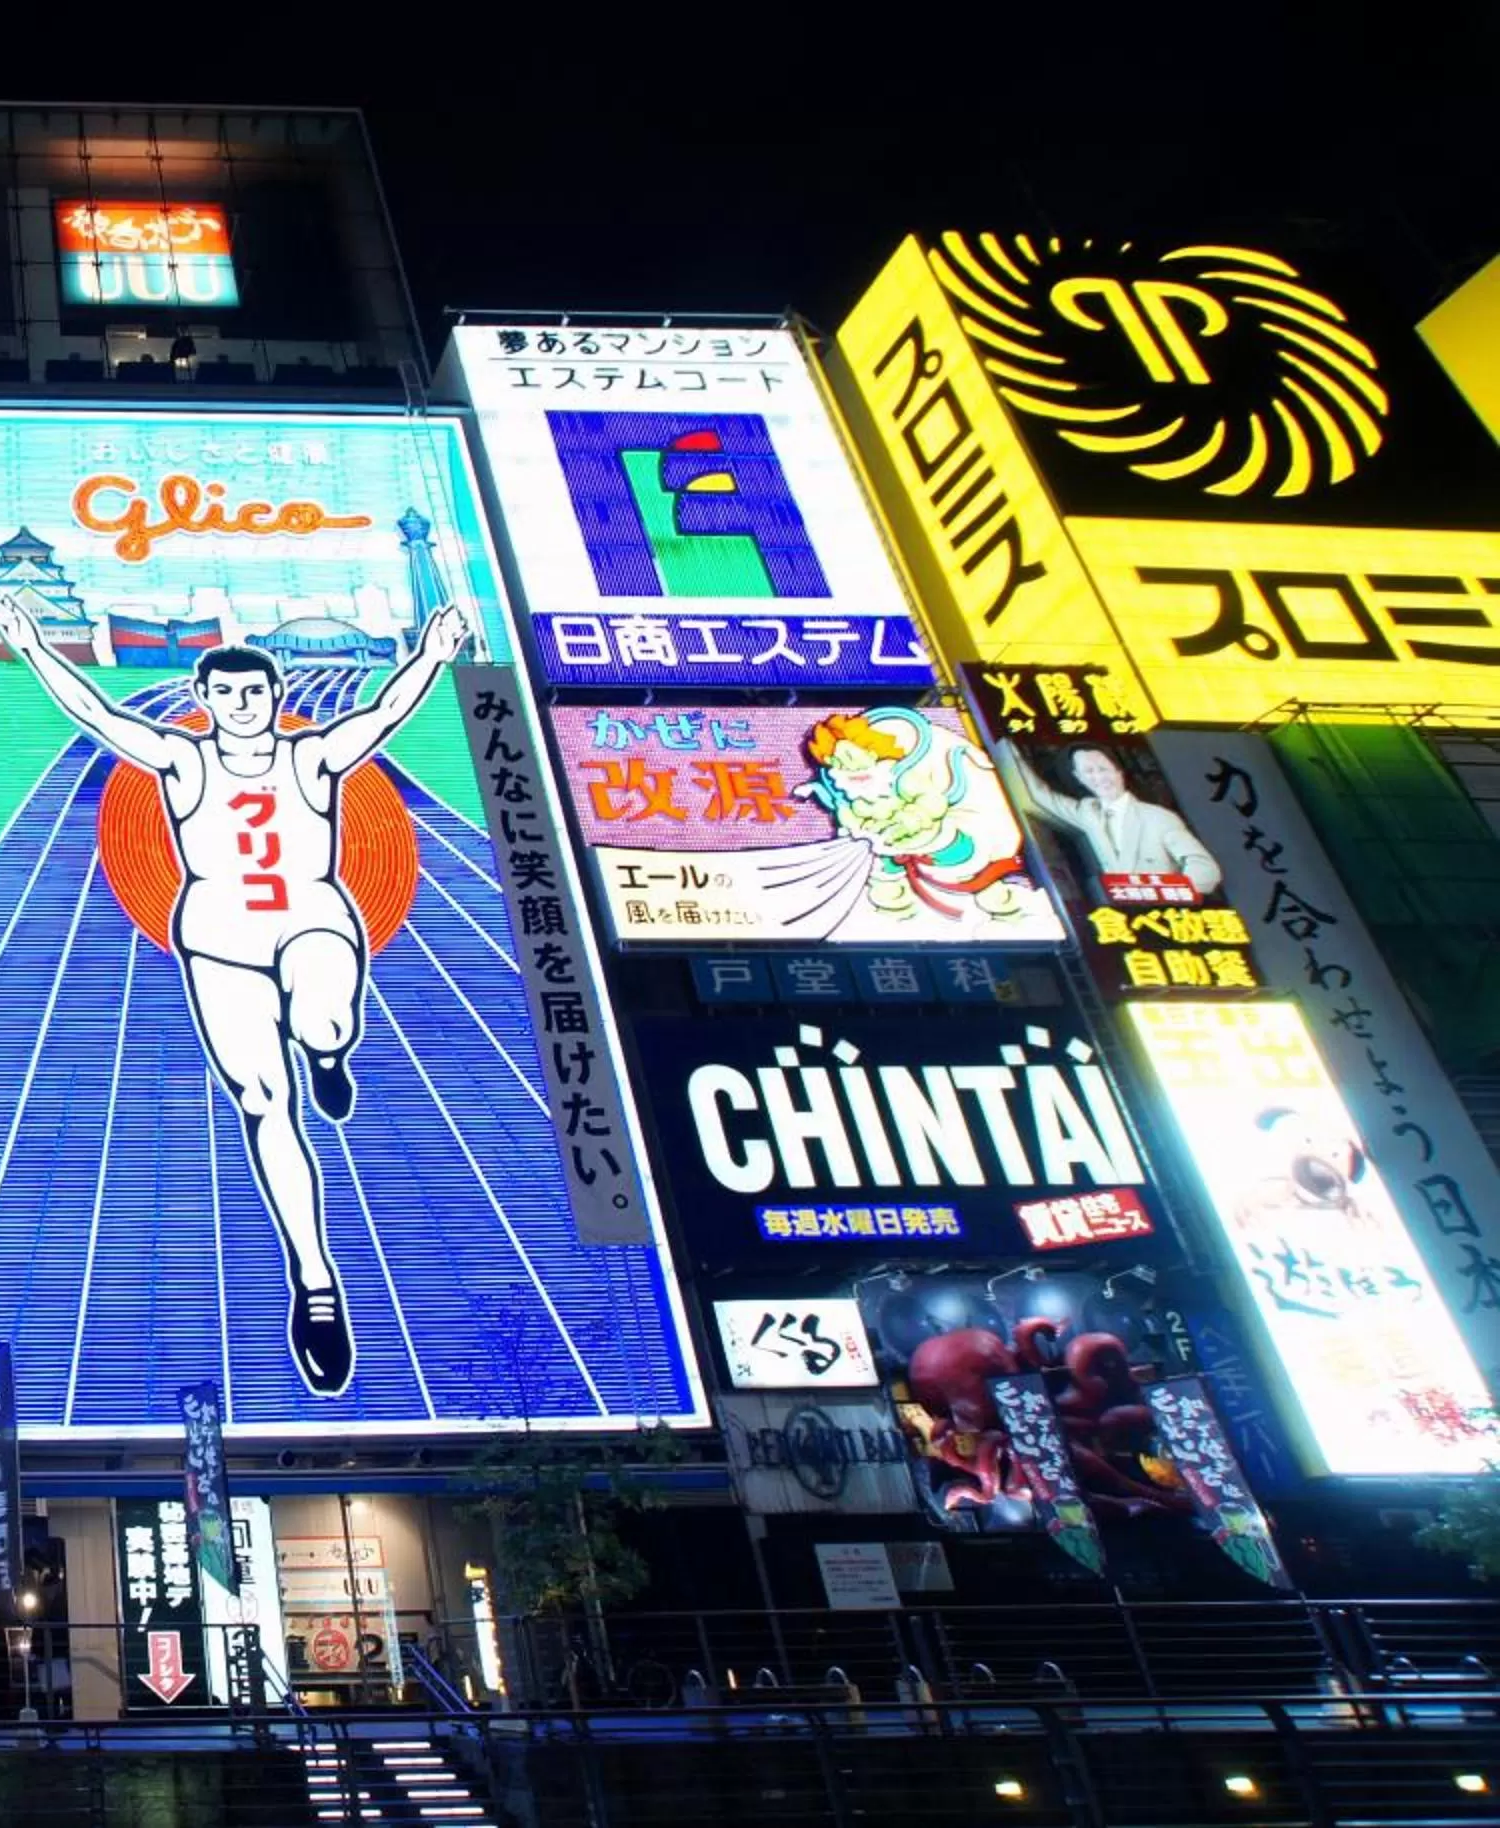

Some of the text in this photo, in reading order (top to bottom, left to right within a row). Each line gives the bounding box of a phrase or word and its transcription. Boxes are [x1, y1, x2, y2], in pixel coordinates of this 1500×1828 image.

[499, 328, 768, 358] 夢あるマンション
[507, 366, 786, 393] エステムコート
[873, 314, 1048, 627] プロミス
[72, 475, 373, 562] Glico
[550, 613, 933, 667] 日商エステム
[1132, 565, 1500, 667] プロミ
[587, 710, 756, 751] かぜに
[579, 757, 796, 823] 改源
[227, 785, 290, 911] グリコ
[471, 689, 630, 1211] みんなに笑顔を届けたい。
[1089, 906, 1253, 944] 食べ放題
[686, 1022, 1146, 1195] CHINTAI
[761, 1207, 961, 1239] 毎週水曜日発売
